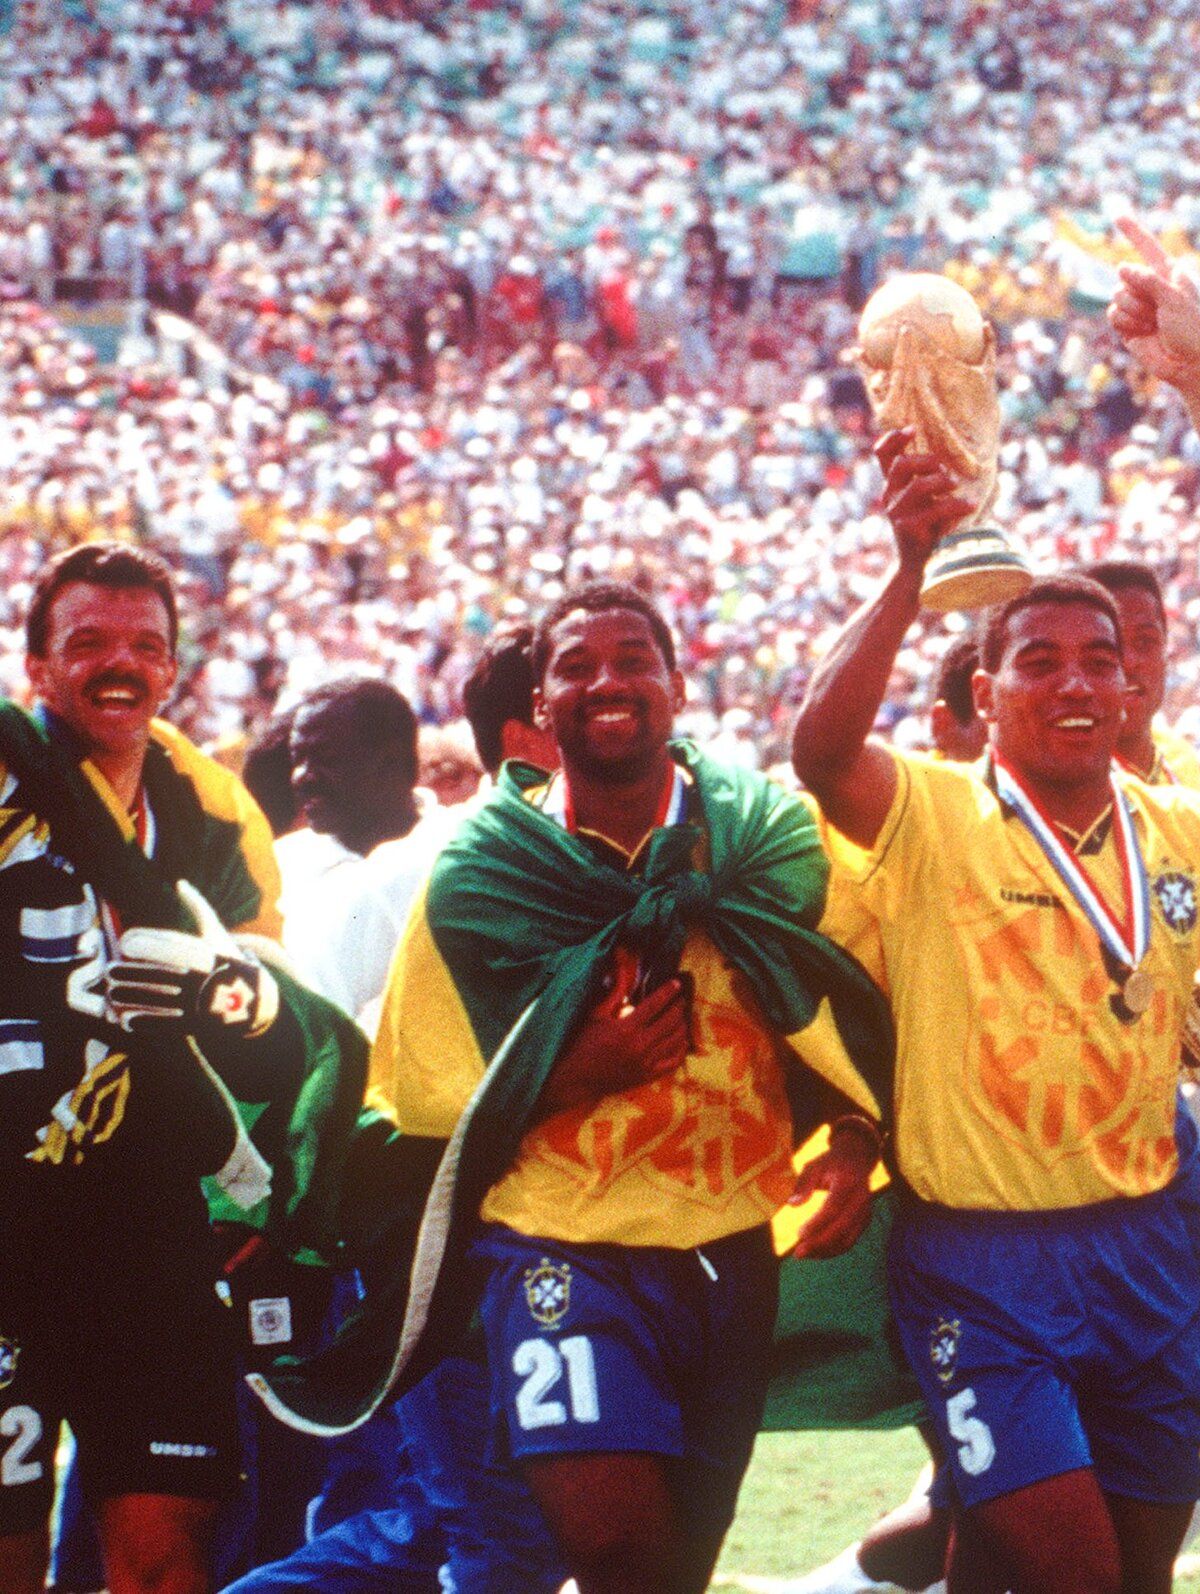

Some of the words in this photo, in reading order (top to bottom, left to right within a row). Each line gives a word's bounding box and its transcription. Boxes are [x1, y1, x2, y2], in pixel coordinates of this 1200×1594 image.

[512, 1334, 601, 1431] 21
[0, 1405, 43, 1485] 2
[946, 1387, 996, 1476] 5
